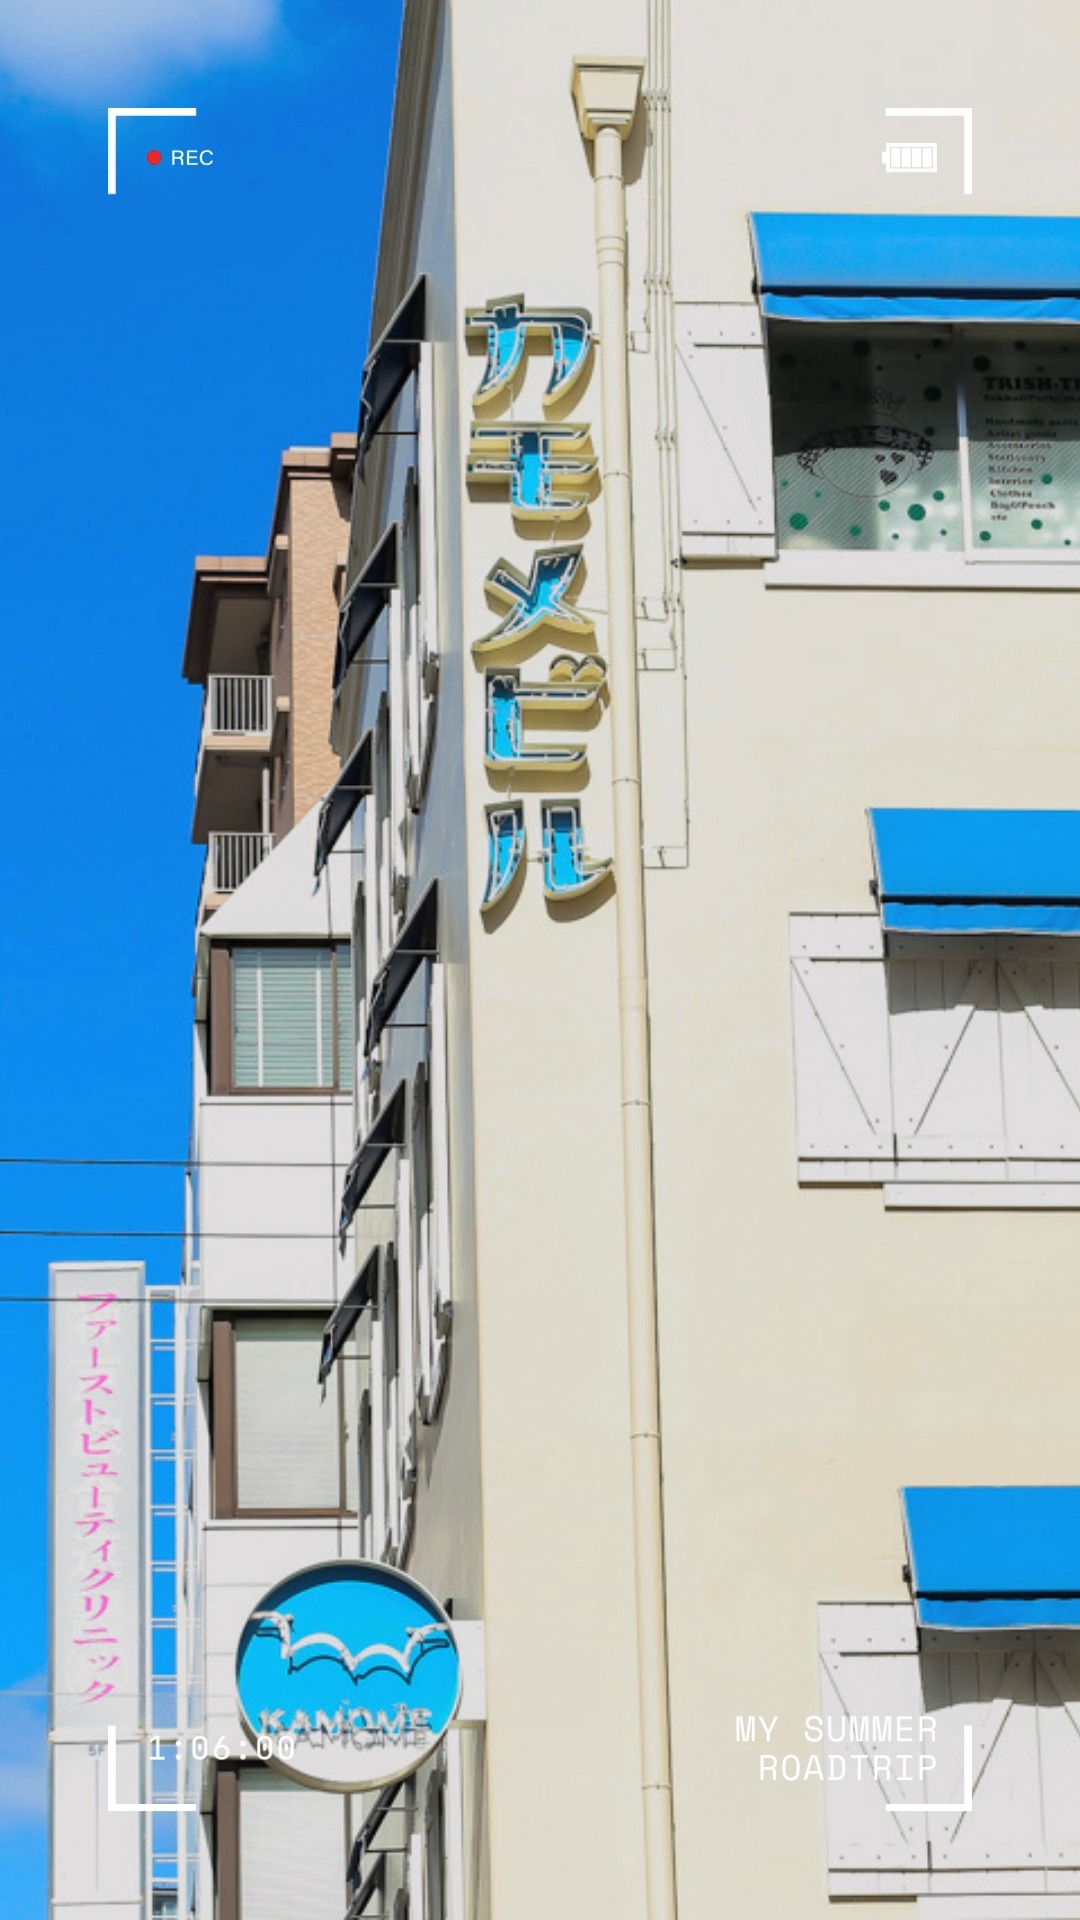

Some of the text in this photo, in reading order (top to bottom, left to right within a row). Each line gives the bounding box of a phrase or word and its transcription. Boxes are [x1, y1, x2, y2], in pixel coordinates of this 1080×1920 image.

[464, 293, 615, 912] カモメビル
[74, 1292, 119, 1704] ファーストビューティクリニック
[259, 1705, 433, 1736] KAMOME
